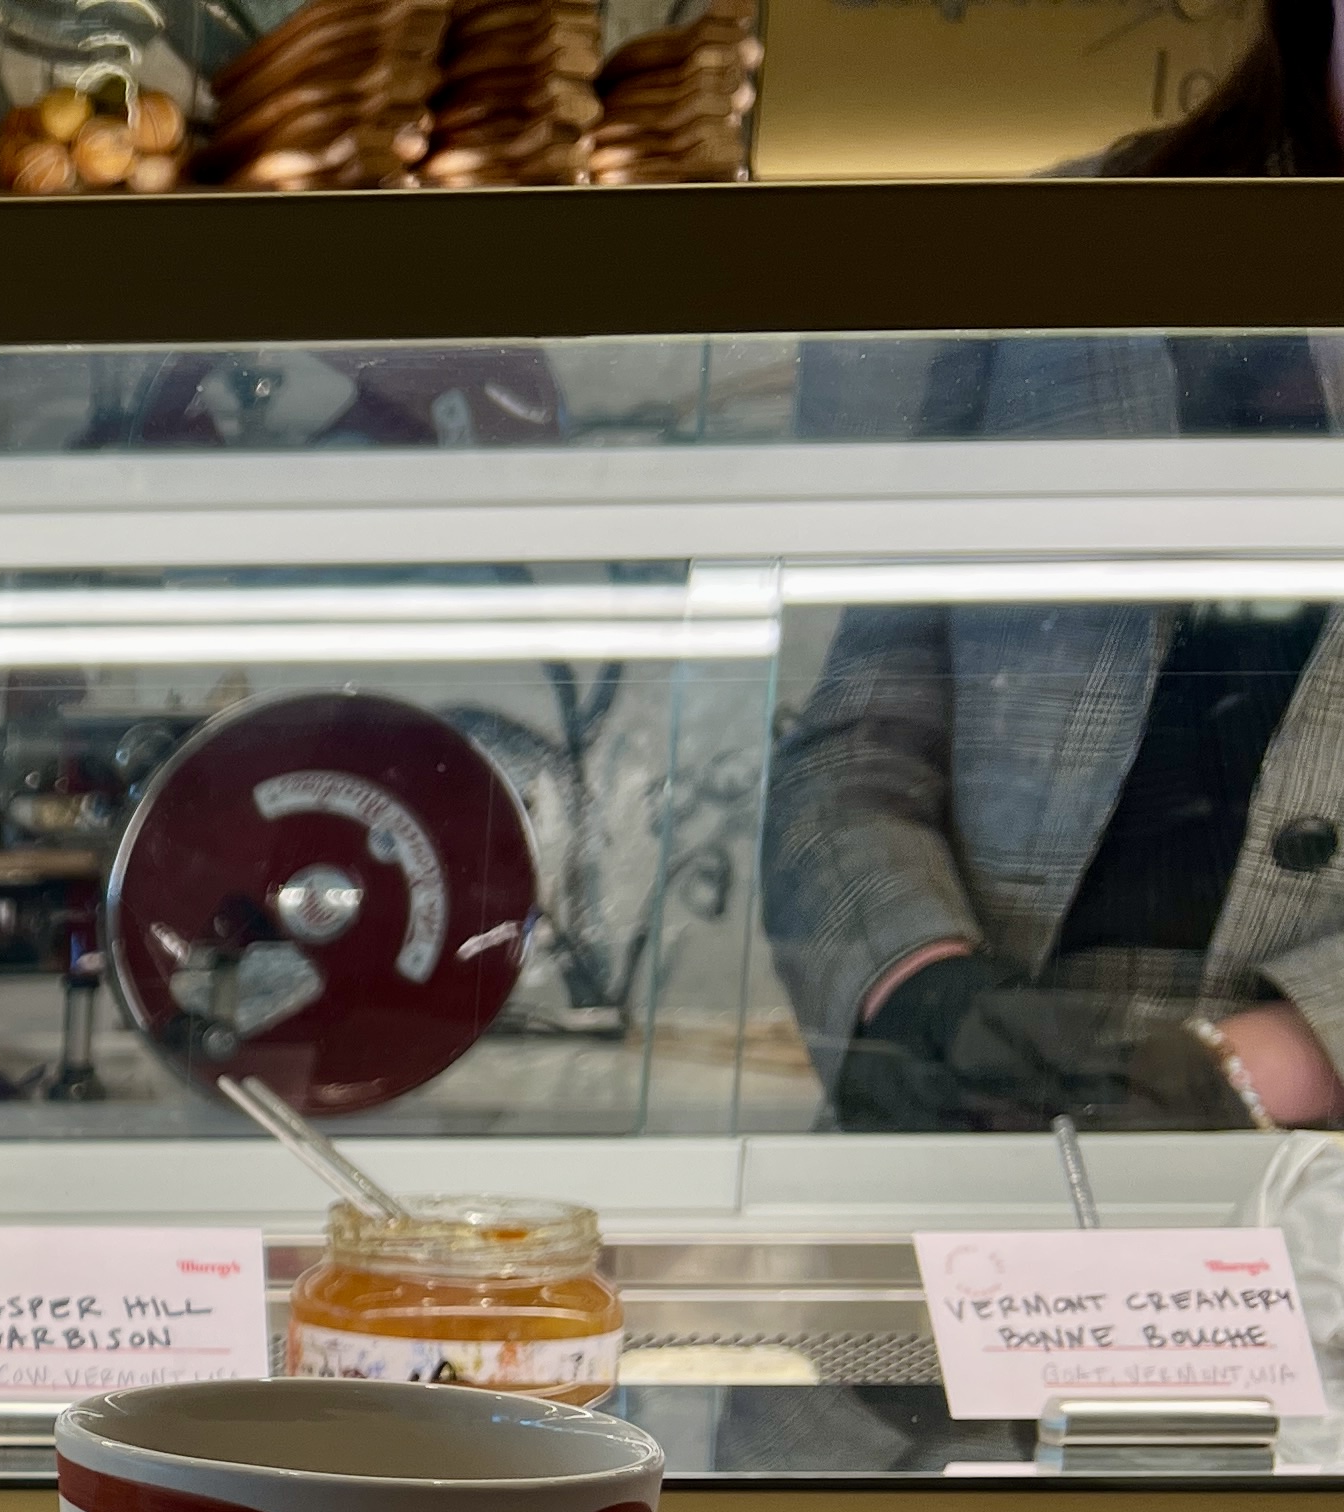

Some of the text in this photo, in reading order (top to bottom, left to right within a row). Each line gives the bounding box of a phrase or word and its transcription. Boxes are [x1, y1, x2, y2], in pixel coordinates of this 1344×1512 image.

[123, 1295, 212, 1319] HILL
[947, 1287, 1295, 1323] VERMONT CREAMERY
[998, 1323, 1267, 1351] BONNE BOUCHE
